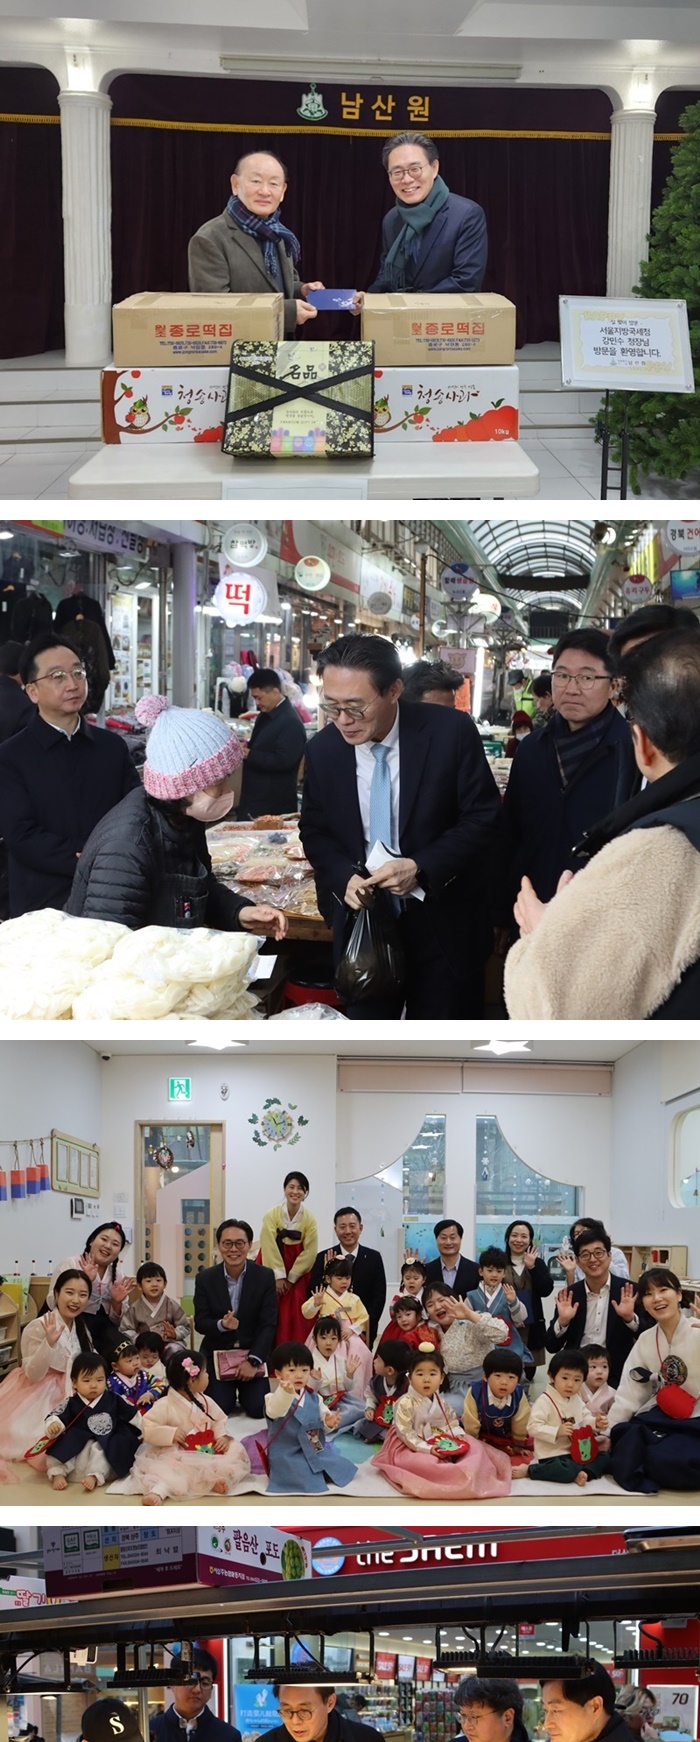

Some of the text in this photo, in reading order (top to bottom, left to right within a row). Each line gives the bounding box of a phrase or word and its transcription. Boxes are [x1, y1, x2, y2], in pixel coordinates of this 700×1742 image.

[341, 92, 430, 122] 남산원
[169, 324, 232, 338] 종로떡집
[425, 322, 485, 336] 종로떡집
[600, 327, 651, 337] 서울지방국세청
[593, 347, 617, 356] 방문을
[279, 364, 318, 380] 名品
[225, 583, 251, 615] 떡
[265, 1540, 280, 1559] 포도
[671, 1692, 689, 1705] 70
[109, 1714, 125, 1735] S
